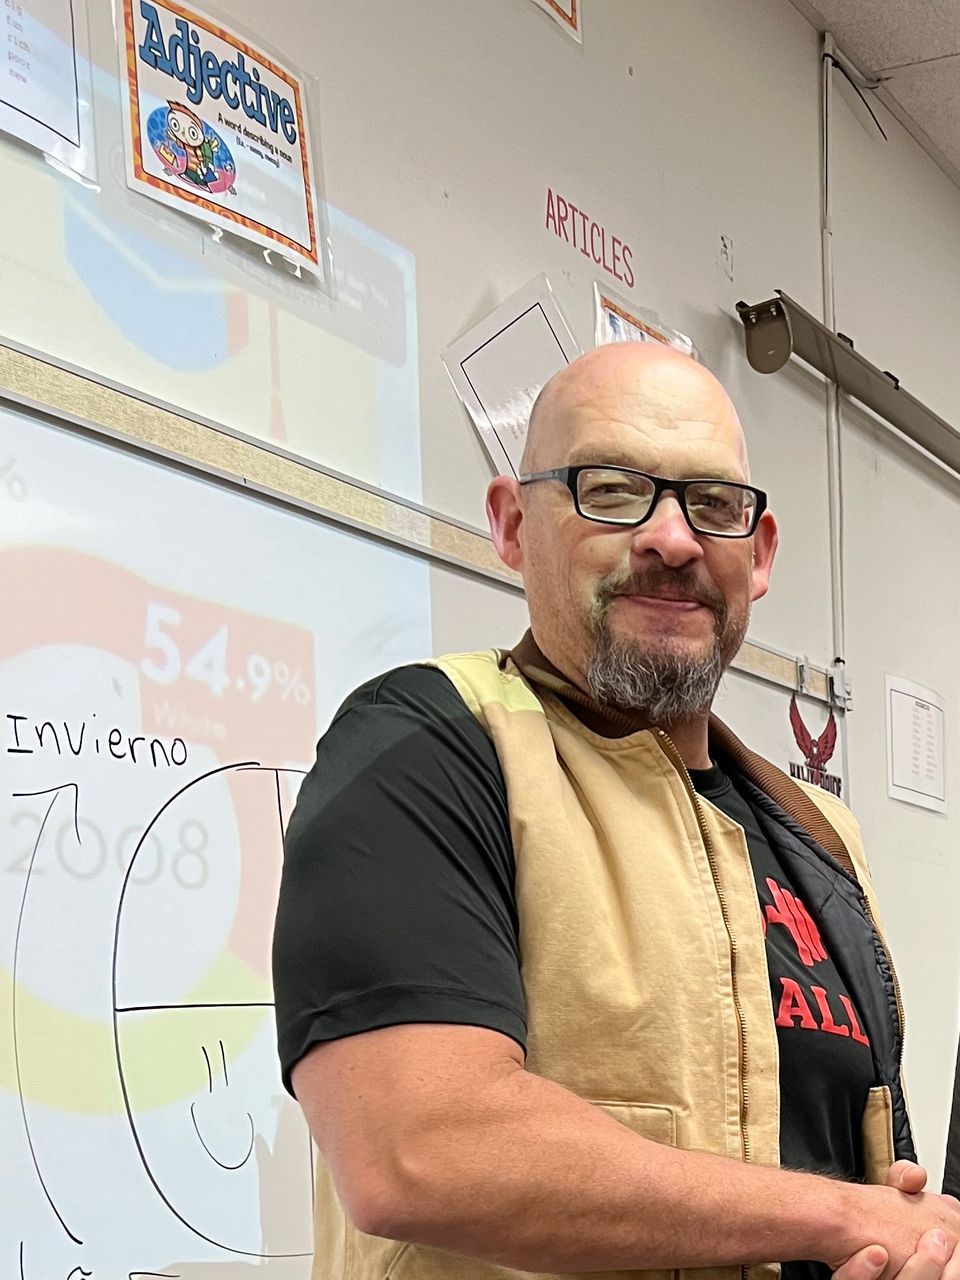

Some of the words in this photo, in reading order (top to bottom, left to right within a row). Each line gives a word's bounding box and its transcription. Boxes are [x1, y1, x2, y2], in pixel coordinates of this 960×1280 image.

[8, 33, 31, 53] rich
[8, 50, 31, 70] poor
[138, 0, 298, 145] Adjective
[217, 112, 224, 124] A
[224, 118, 242, 134] word
[243, 127, 275, 155] describing
[546, 187, 634, 288] ARTICLES
[7, 713, 188, 767] Invierno
[4, 808, 209, 890] 2008
